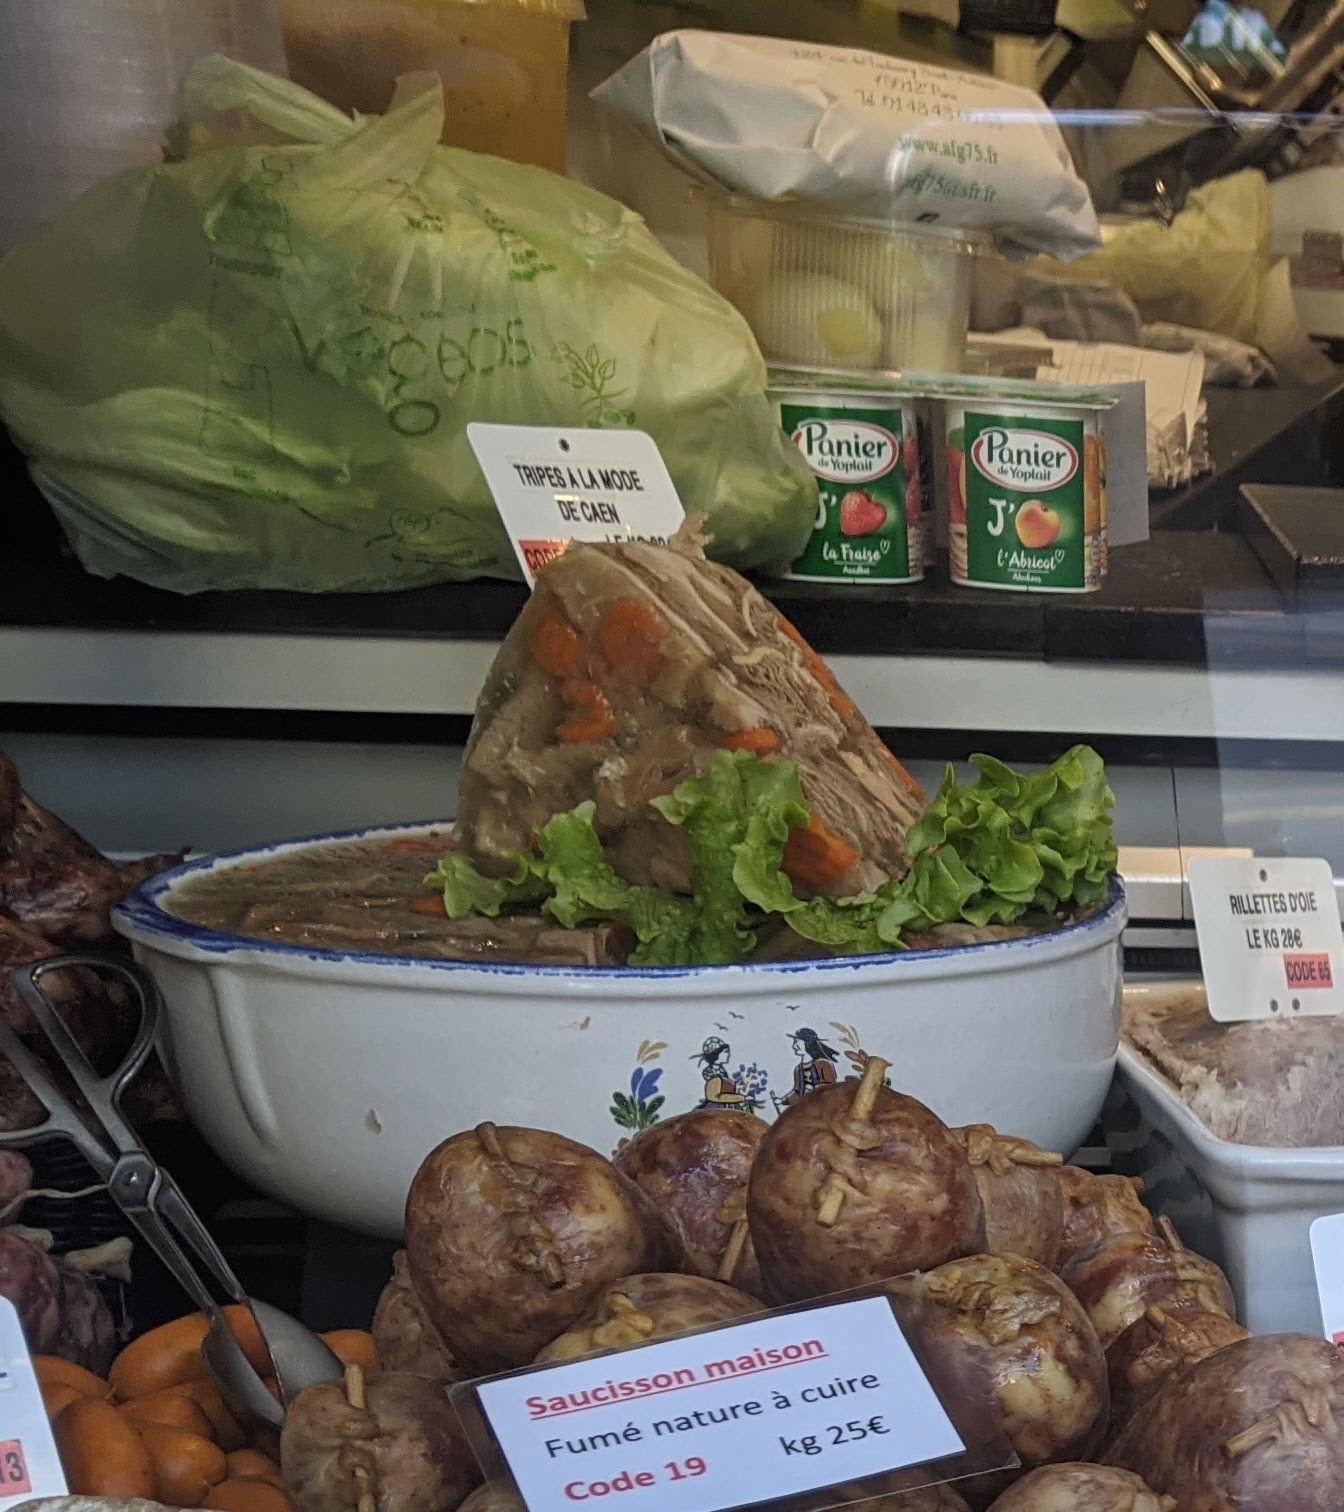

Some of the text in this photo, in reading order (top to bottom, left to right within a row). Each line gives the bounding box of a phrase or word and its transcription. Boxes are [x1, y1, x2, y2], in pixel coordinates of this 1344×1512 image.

[802, 420, 888, 459] Panier
[981, 428, 1067, 468] Panier
[513, 464, 567, 488] TRIPES
[580, 468, 600, 490] LA
[600, 469, 645, 492] MODE
[830, 457, 873, 474] Yoplait
[1009, 466, 1052, 482] Yoplait
[557, 500, 621, 525] DE CAEN
[1229, 891, 1318, 916] RILLETTES D'OIE
[1246, 928, 1304, 950] LE KG 28€
[1286, 962, 1316, 982] CODE
[525, 1337, 825, 1419] Saucisson maison
[544, 1370, 881, 1459] Fumé nature à cuire
[779, 1413, 891, 1458] kg 25€
[564, 1455, 708, 1502] Code 19
